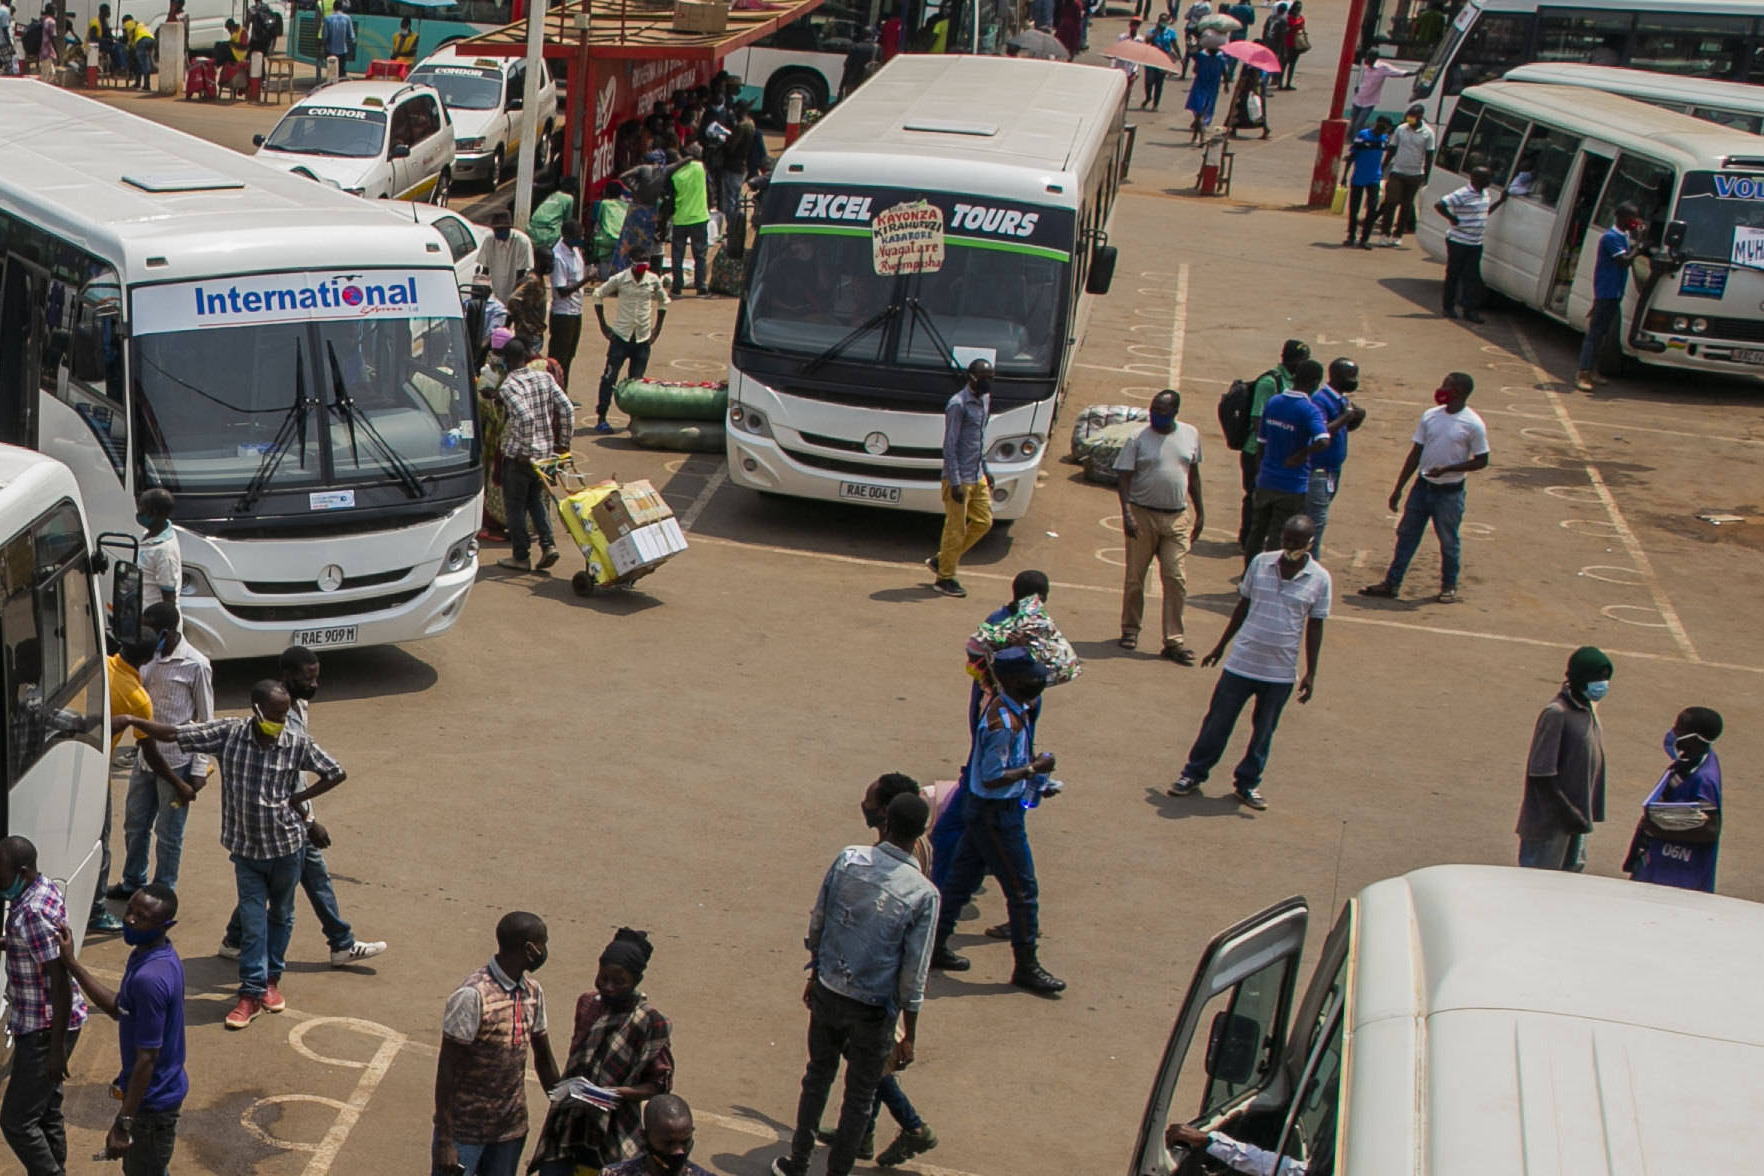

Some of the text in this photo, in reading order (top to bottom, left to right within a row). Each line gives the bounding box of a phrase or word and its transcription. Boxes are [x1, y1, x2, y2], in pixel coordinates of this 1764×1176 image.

[307, 107, 367, 121] CONDOR
[794, 193, 1039, 238] EXCEL TOURS
[877, 209, 938, 227] KAYONZA
[194, 276, 418, 316] International
[847, 484, 867, 497] RAE
[301, 631, 322, 645] RAE
[325, 628, 345, 643] 909
